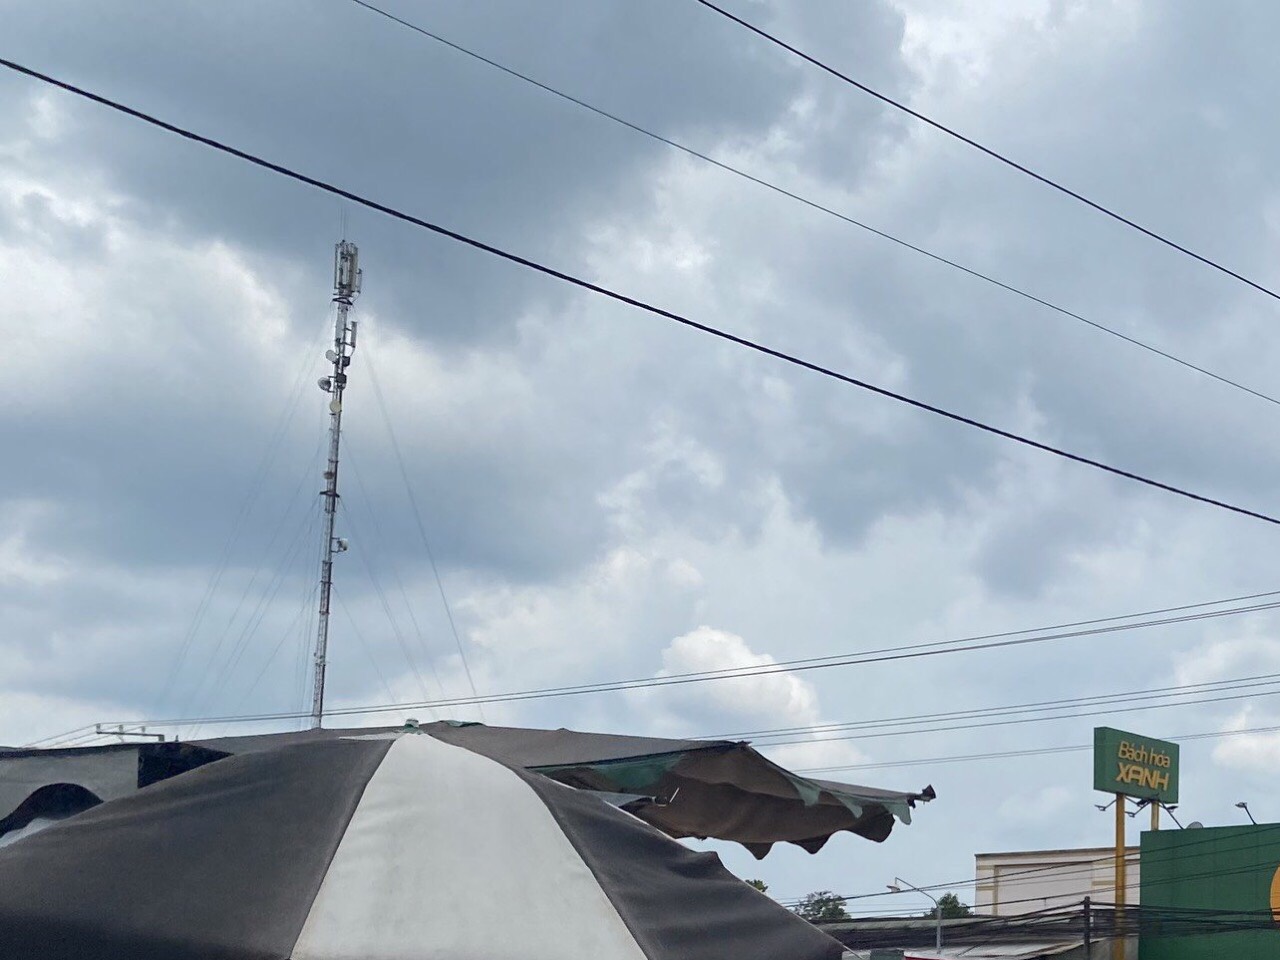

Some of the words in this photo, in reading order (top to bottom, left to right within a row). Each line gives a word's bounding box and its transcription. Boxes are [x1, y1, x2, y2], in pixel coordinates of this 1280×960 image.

[1118, 740, 1147, 763] Bách
[1149, 747, 1171, 768] hóa
[1116, 762, 1169, 791] XANH
